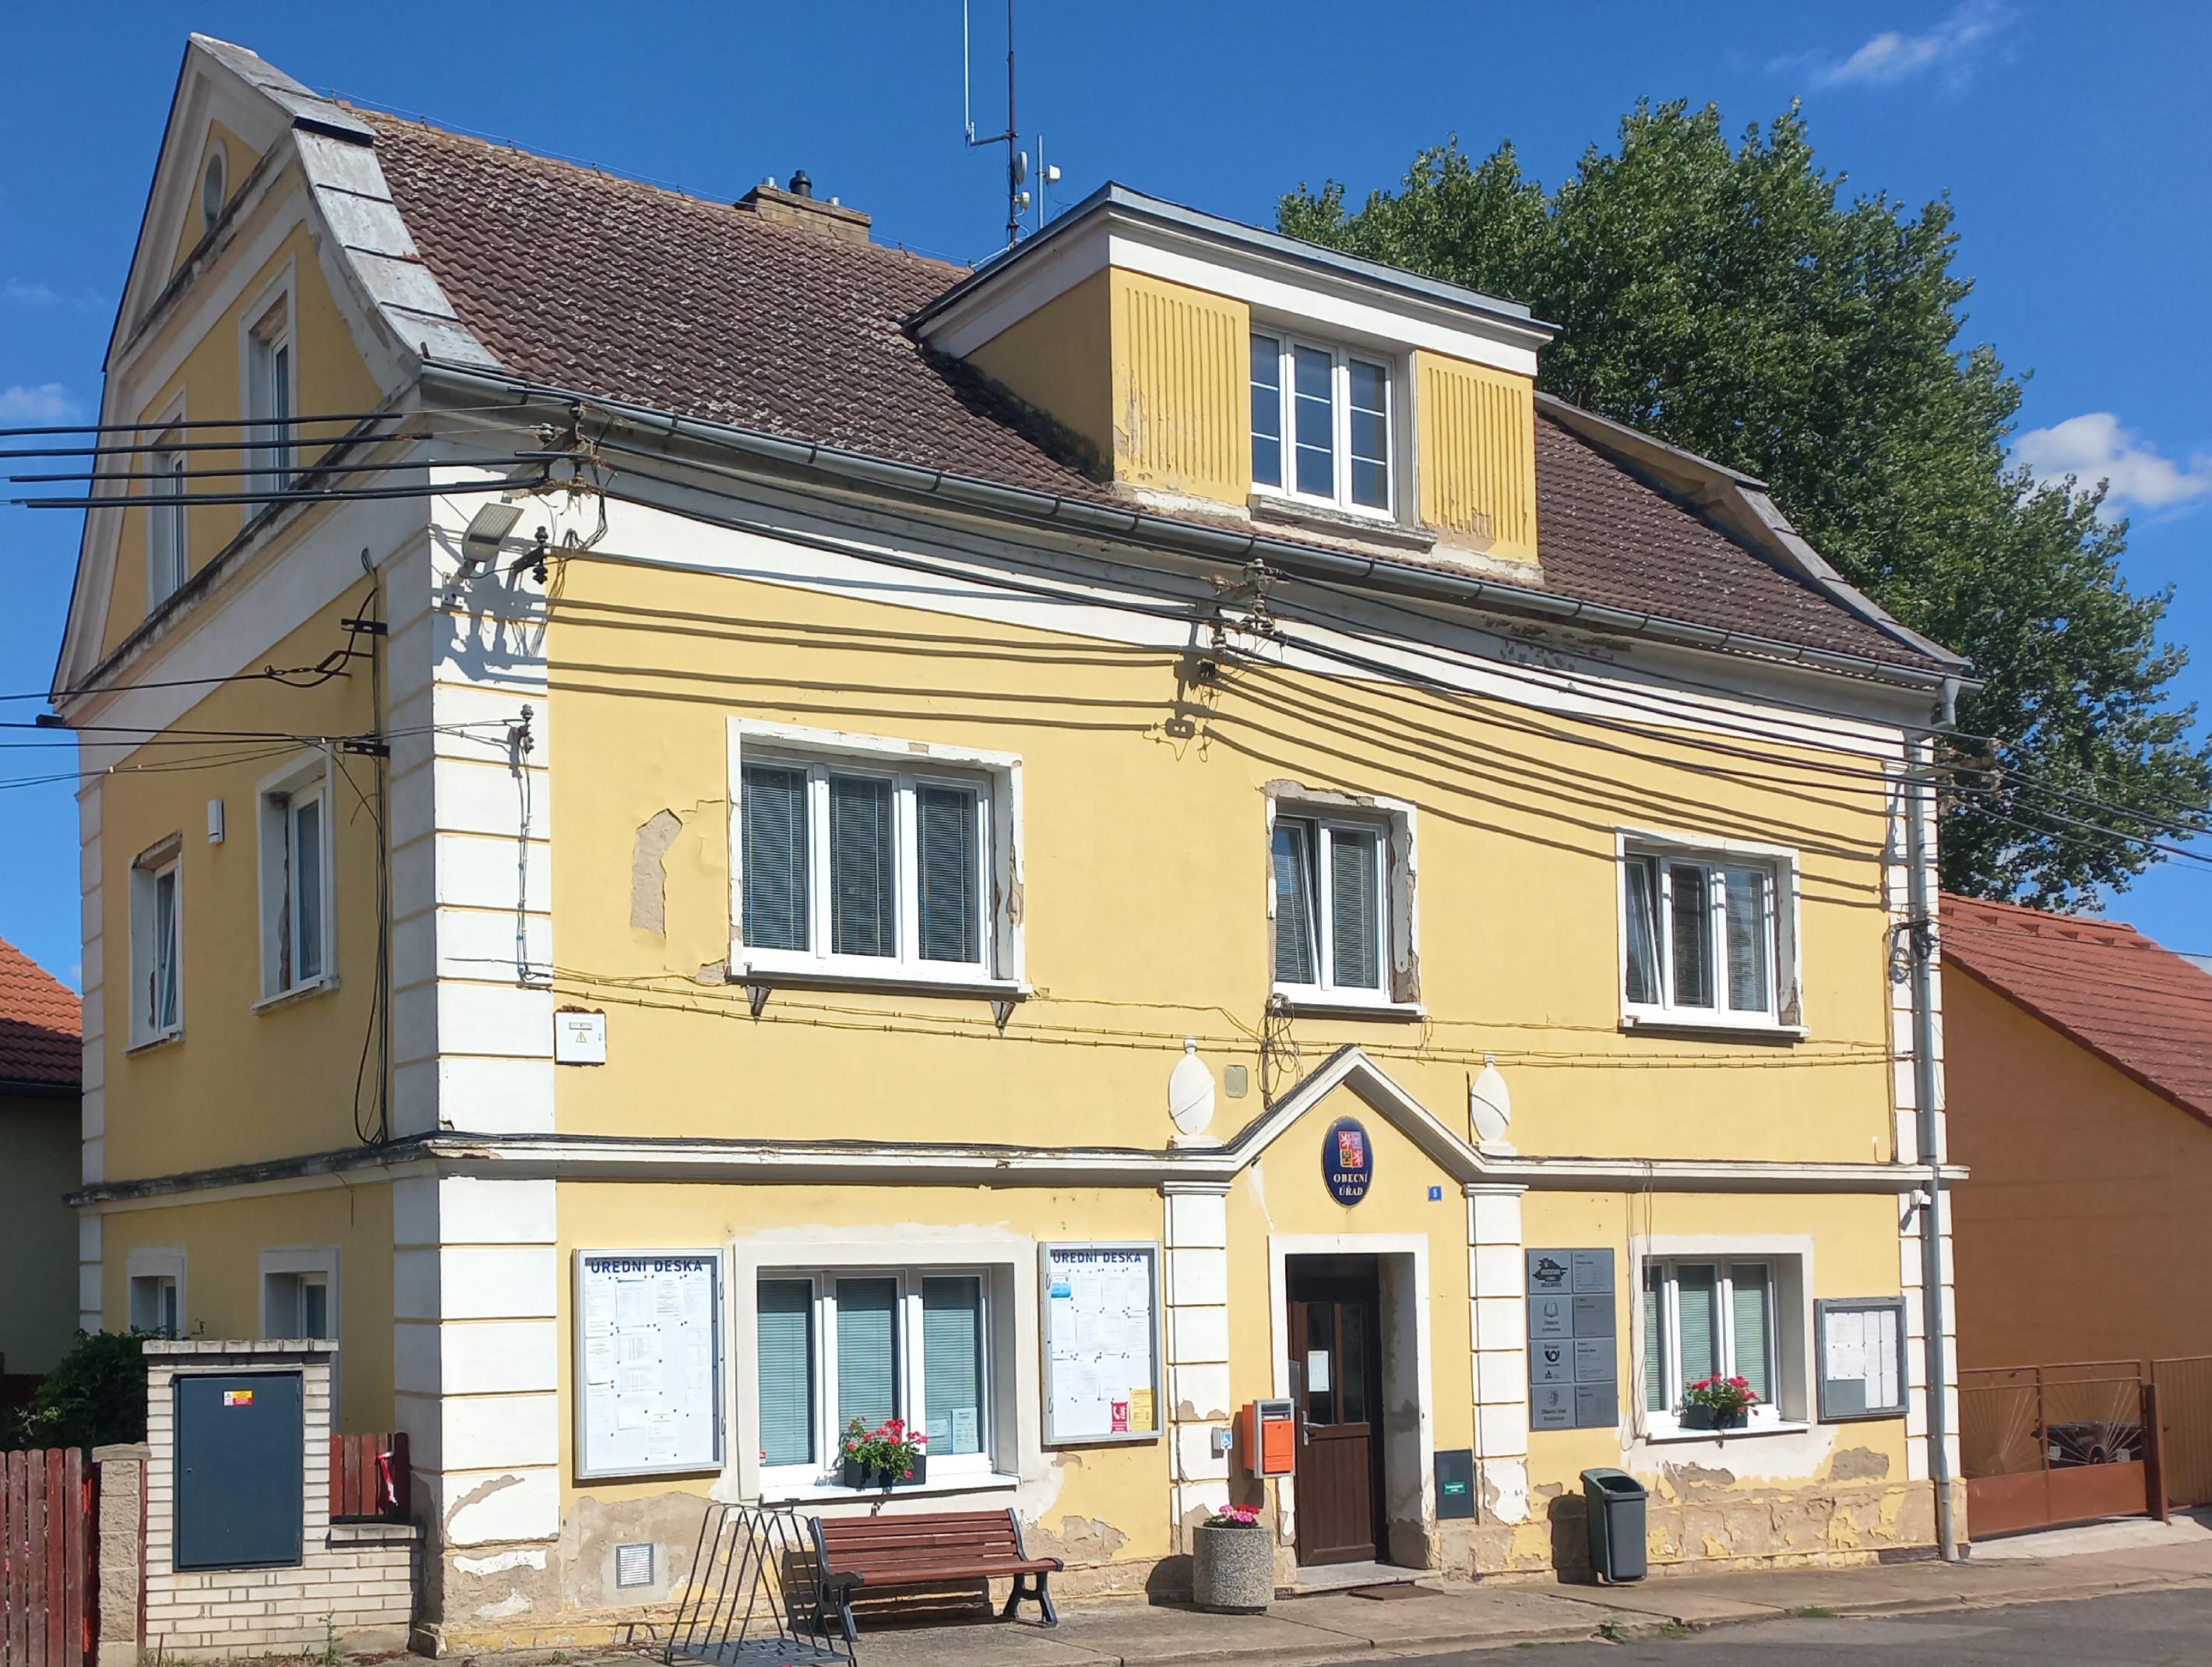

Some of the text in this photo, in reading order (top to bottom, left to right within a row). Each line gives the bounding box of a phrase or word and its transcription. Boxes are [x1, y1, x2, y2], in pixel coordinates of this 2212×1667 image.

[1333, 1171, 1368, 1183] OBECNÍ
[1339, 1184, 1363, 1196] ÚŘAD
[1103, 1252, 1142, 1263] DESKA
[654, 1260, 703, 1272] DESKA
